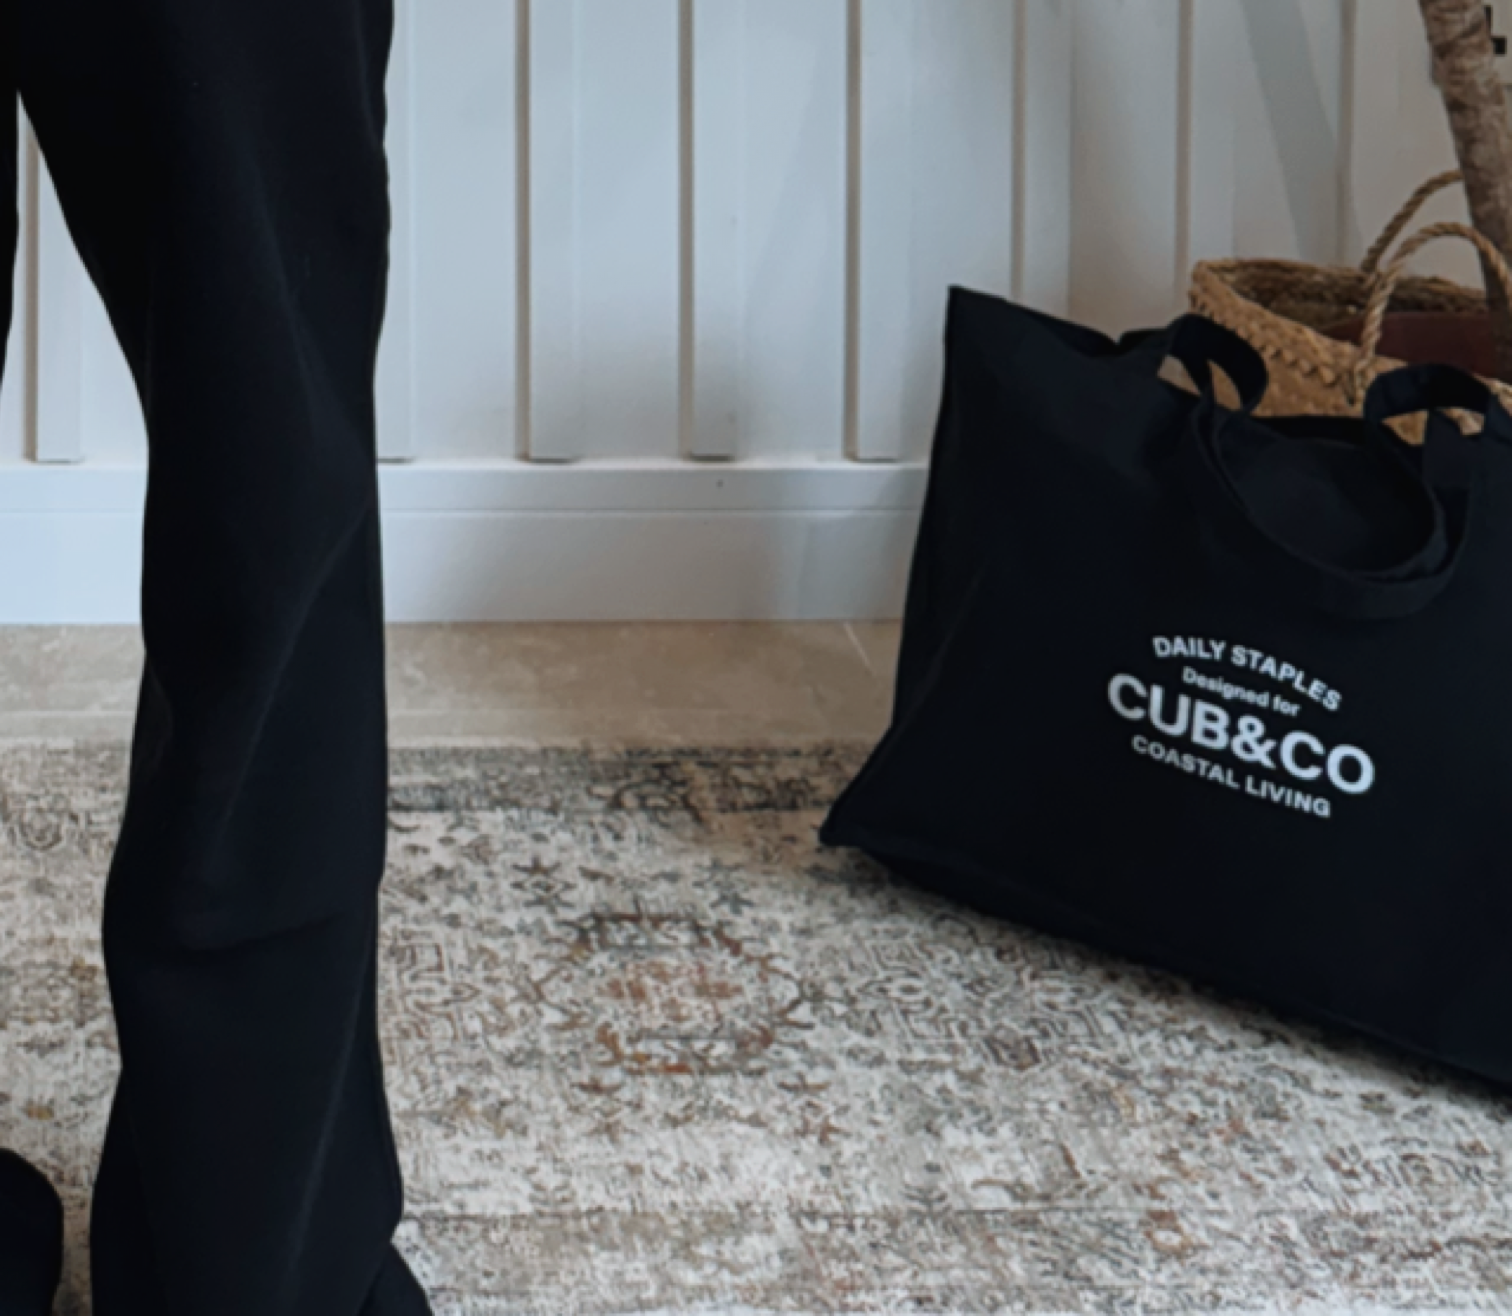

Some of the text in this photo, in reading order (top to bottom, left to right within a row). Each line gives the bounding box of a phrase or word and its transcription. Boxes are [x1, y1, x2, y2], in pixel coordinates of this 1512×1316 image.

[1152, 635, 1342, 712] DAILY STAPLES
[1182, 666, 1301, 718] Designed for
[1107, 673, 1376, 795] CUB&CO
[1131, 734, 1332, 818] COASTAL LIVING
